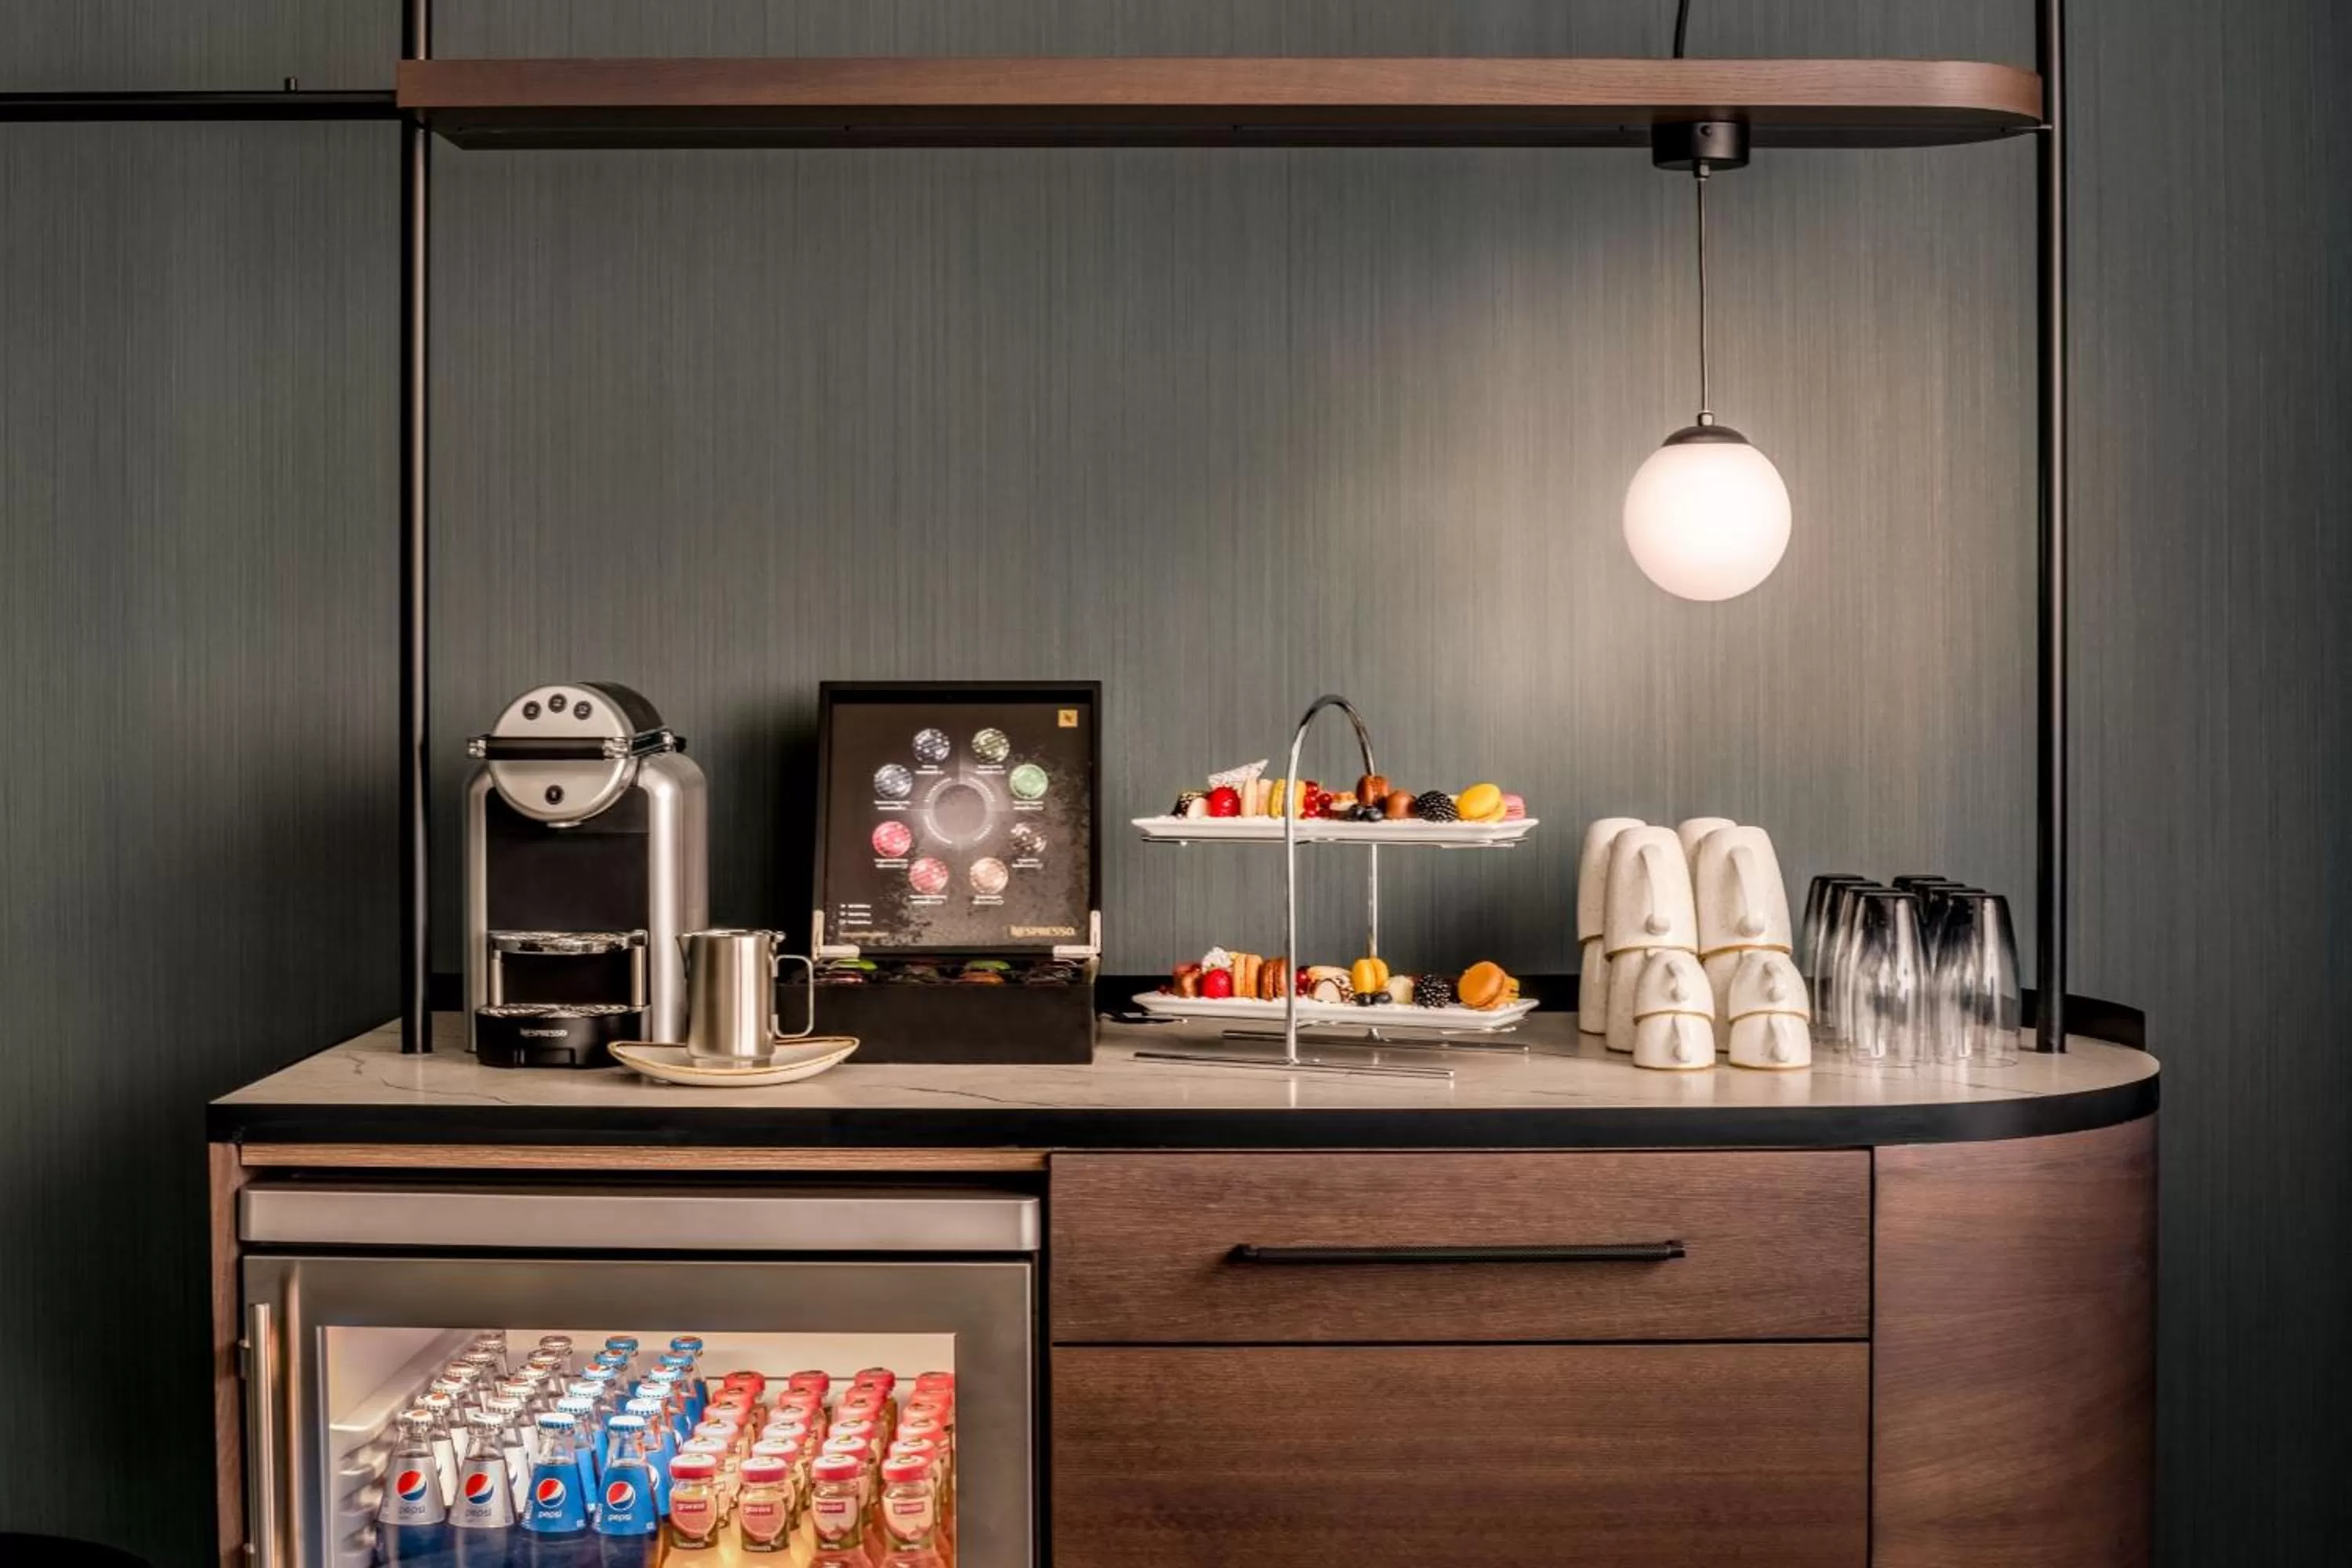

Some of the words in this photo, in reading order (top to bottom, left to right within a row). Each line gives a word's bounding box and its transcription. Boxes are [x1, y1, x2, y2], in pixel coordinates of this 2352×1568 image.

[398, 1505, 425, 1515] pepsi
[538, 1509, 562, 1519] pepsi
[608, 1513, 633, 1522] pepsi
